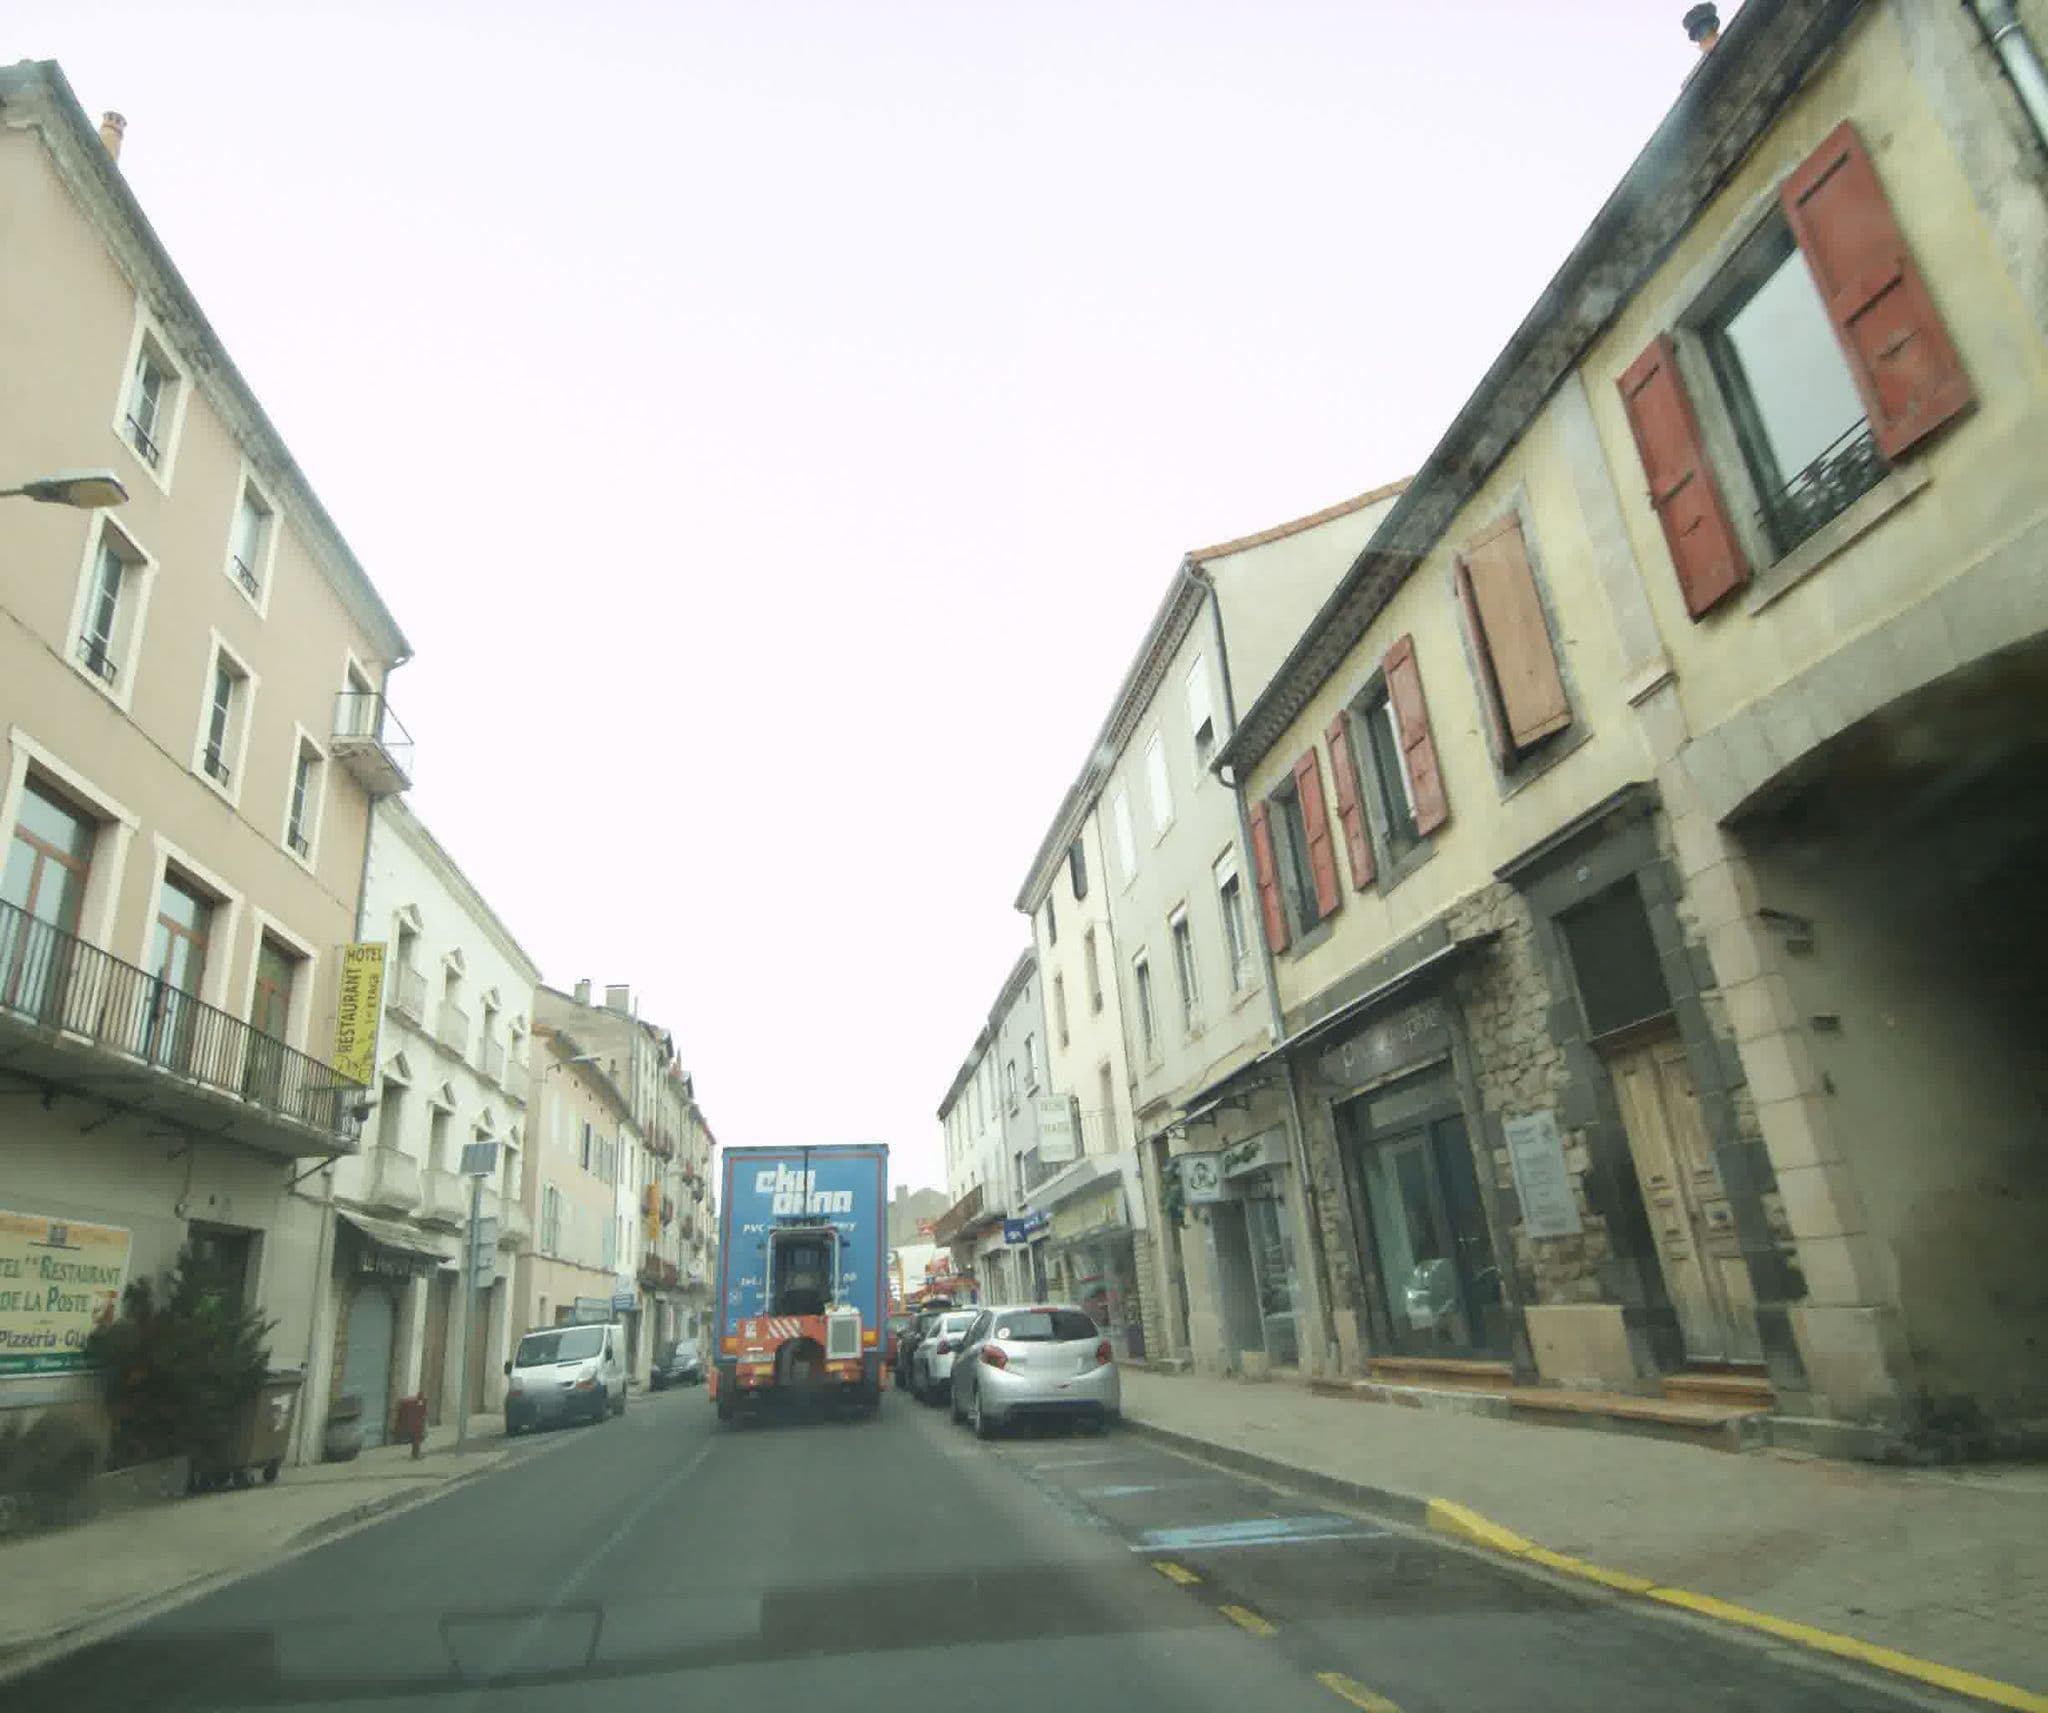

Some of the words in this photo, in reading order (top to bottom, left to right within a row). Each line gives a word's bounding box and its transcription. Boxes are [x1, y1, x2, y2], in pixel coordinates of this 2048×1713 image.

[347, 948, 382, 962] HOTEL
[338, 968, 361, 1053] RESTAURANT
[40, 1255, 121, 1285] RESTAURANT
[24, 1291, 41, 1312] LA
[47, 1286, 90, 1313] POSTE
